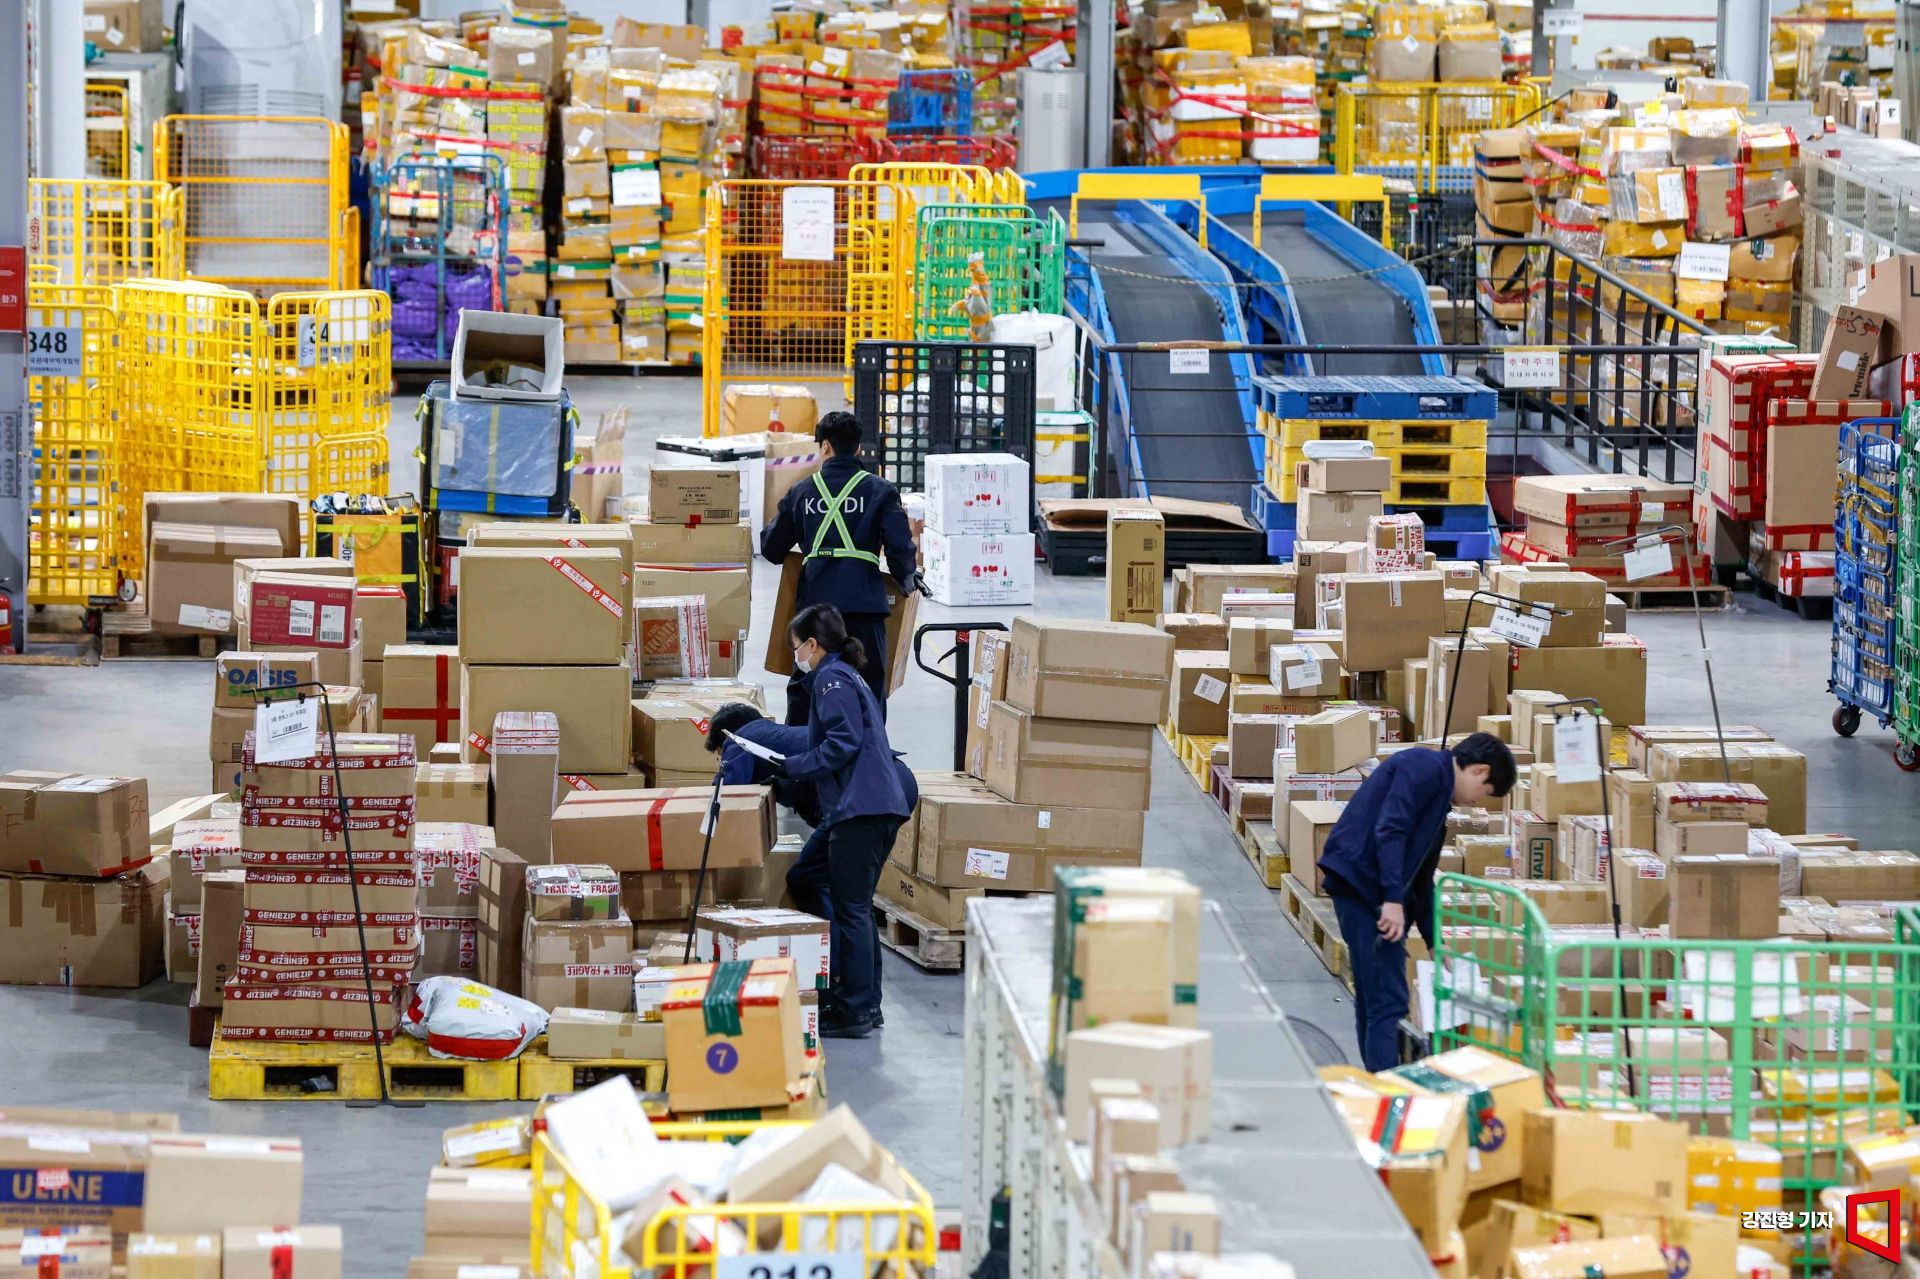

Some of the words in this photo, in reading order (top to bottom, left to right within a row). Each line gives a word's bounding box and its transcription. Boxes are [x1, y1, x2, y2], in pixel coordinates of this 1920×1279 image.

[362, 798, 401, 806] GENIEZIP
[282, 818, 321, 827] GENIEZIP
[285, 852, 325, 861] GENIEZIP
[900, 880, 914, 898] PING
[257, 911, 297, 920] GENIEZIP
[316, 912, 355, 922] GENIEZIP
[375, 913, 414, 923] GENIEZIP
[270, 956, 309, 965] GENIEZIP
[275, 970, 314, 980] GENIEZIP
[567, 965, 600, 976] FRAGILE
[274, 1028, 314, 1037] GENIEZIP
[333, 1030, 372, 1039] GENIEZIP
[715, 1048, 728, 1068] 7
